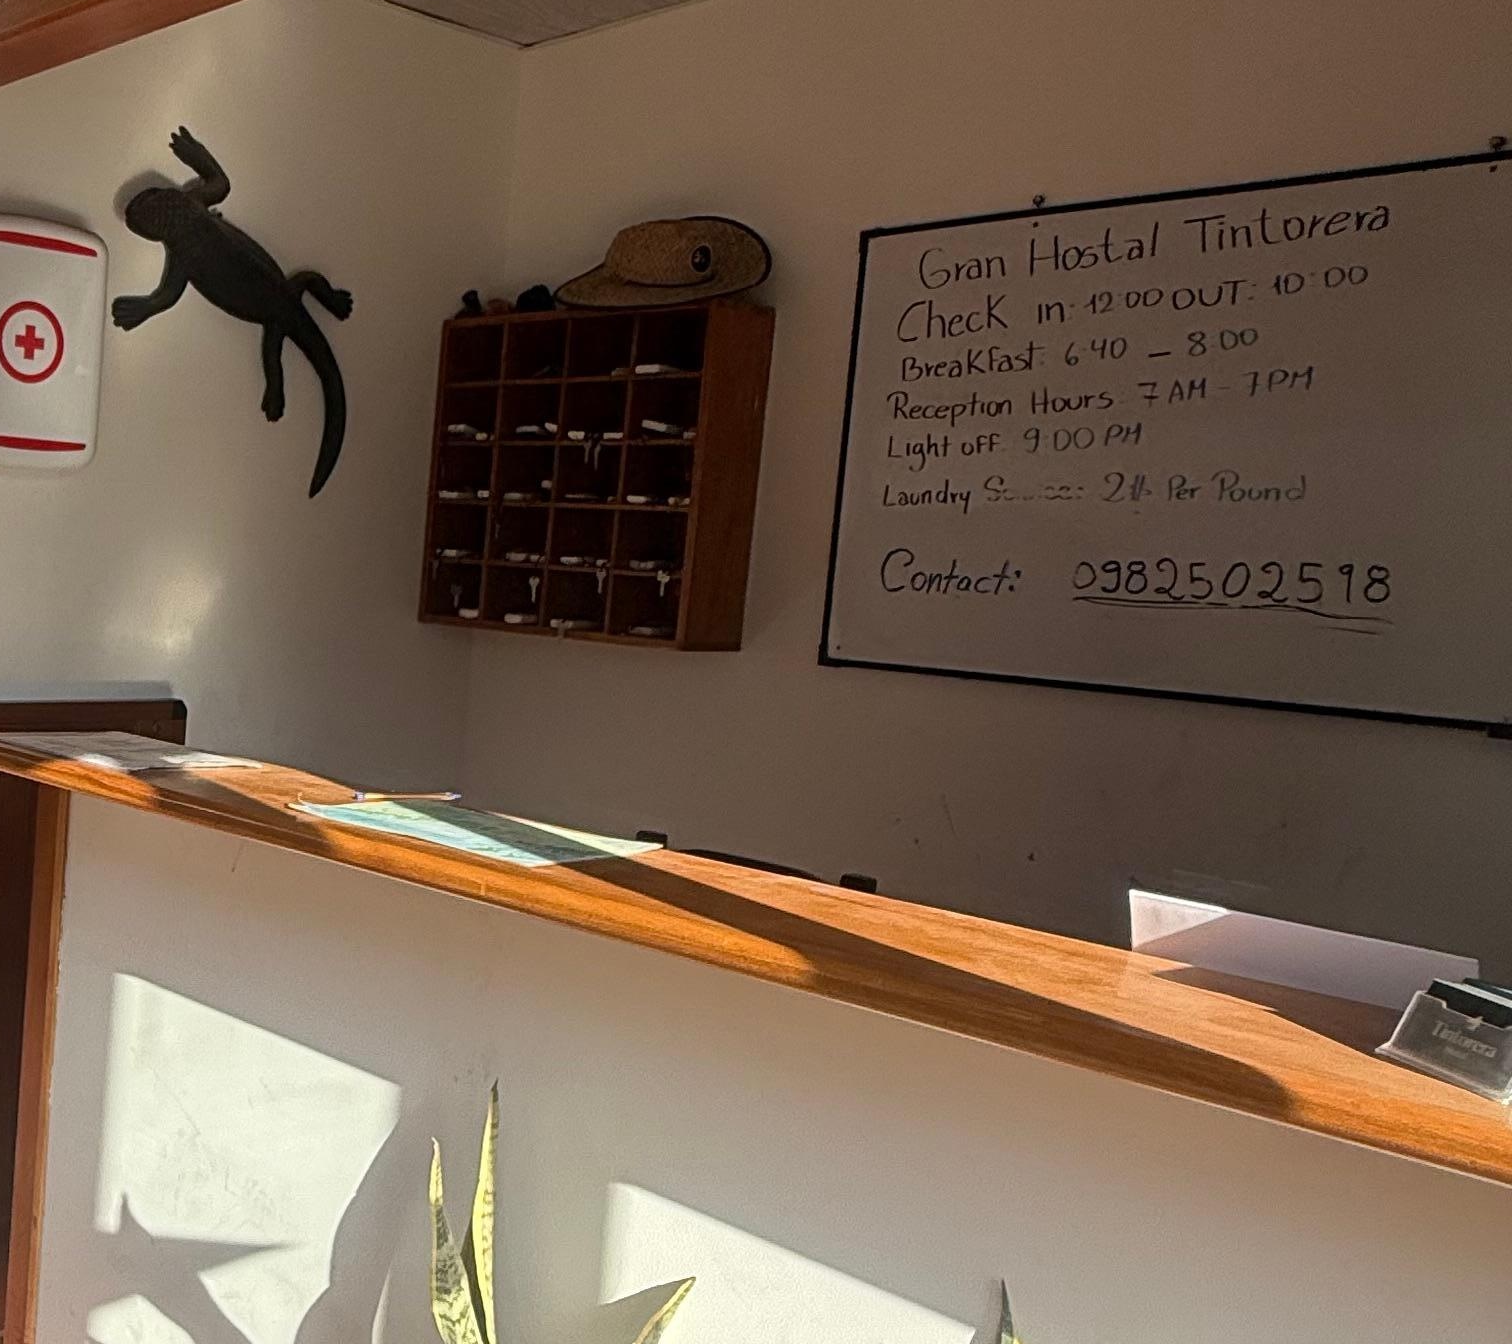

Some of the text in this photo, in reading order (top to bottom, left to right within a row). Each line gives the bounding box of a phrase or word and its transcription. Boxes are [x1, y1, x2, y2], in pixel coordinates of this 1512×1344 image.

[918, 206, 1388, 289] Gran Hostal Tintorera
[886, 391, 1012, 427] Reception
[888, 433, 952, 472] Light
[1104, 422, 1142, 447] PM
[883, 479, 971, 514] Laundry
[1168, 475, 1202, 501] Per
[1211, 469, 1307, 502] Pound
[881, 548, 1022, 595] Contact:
